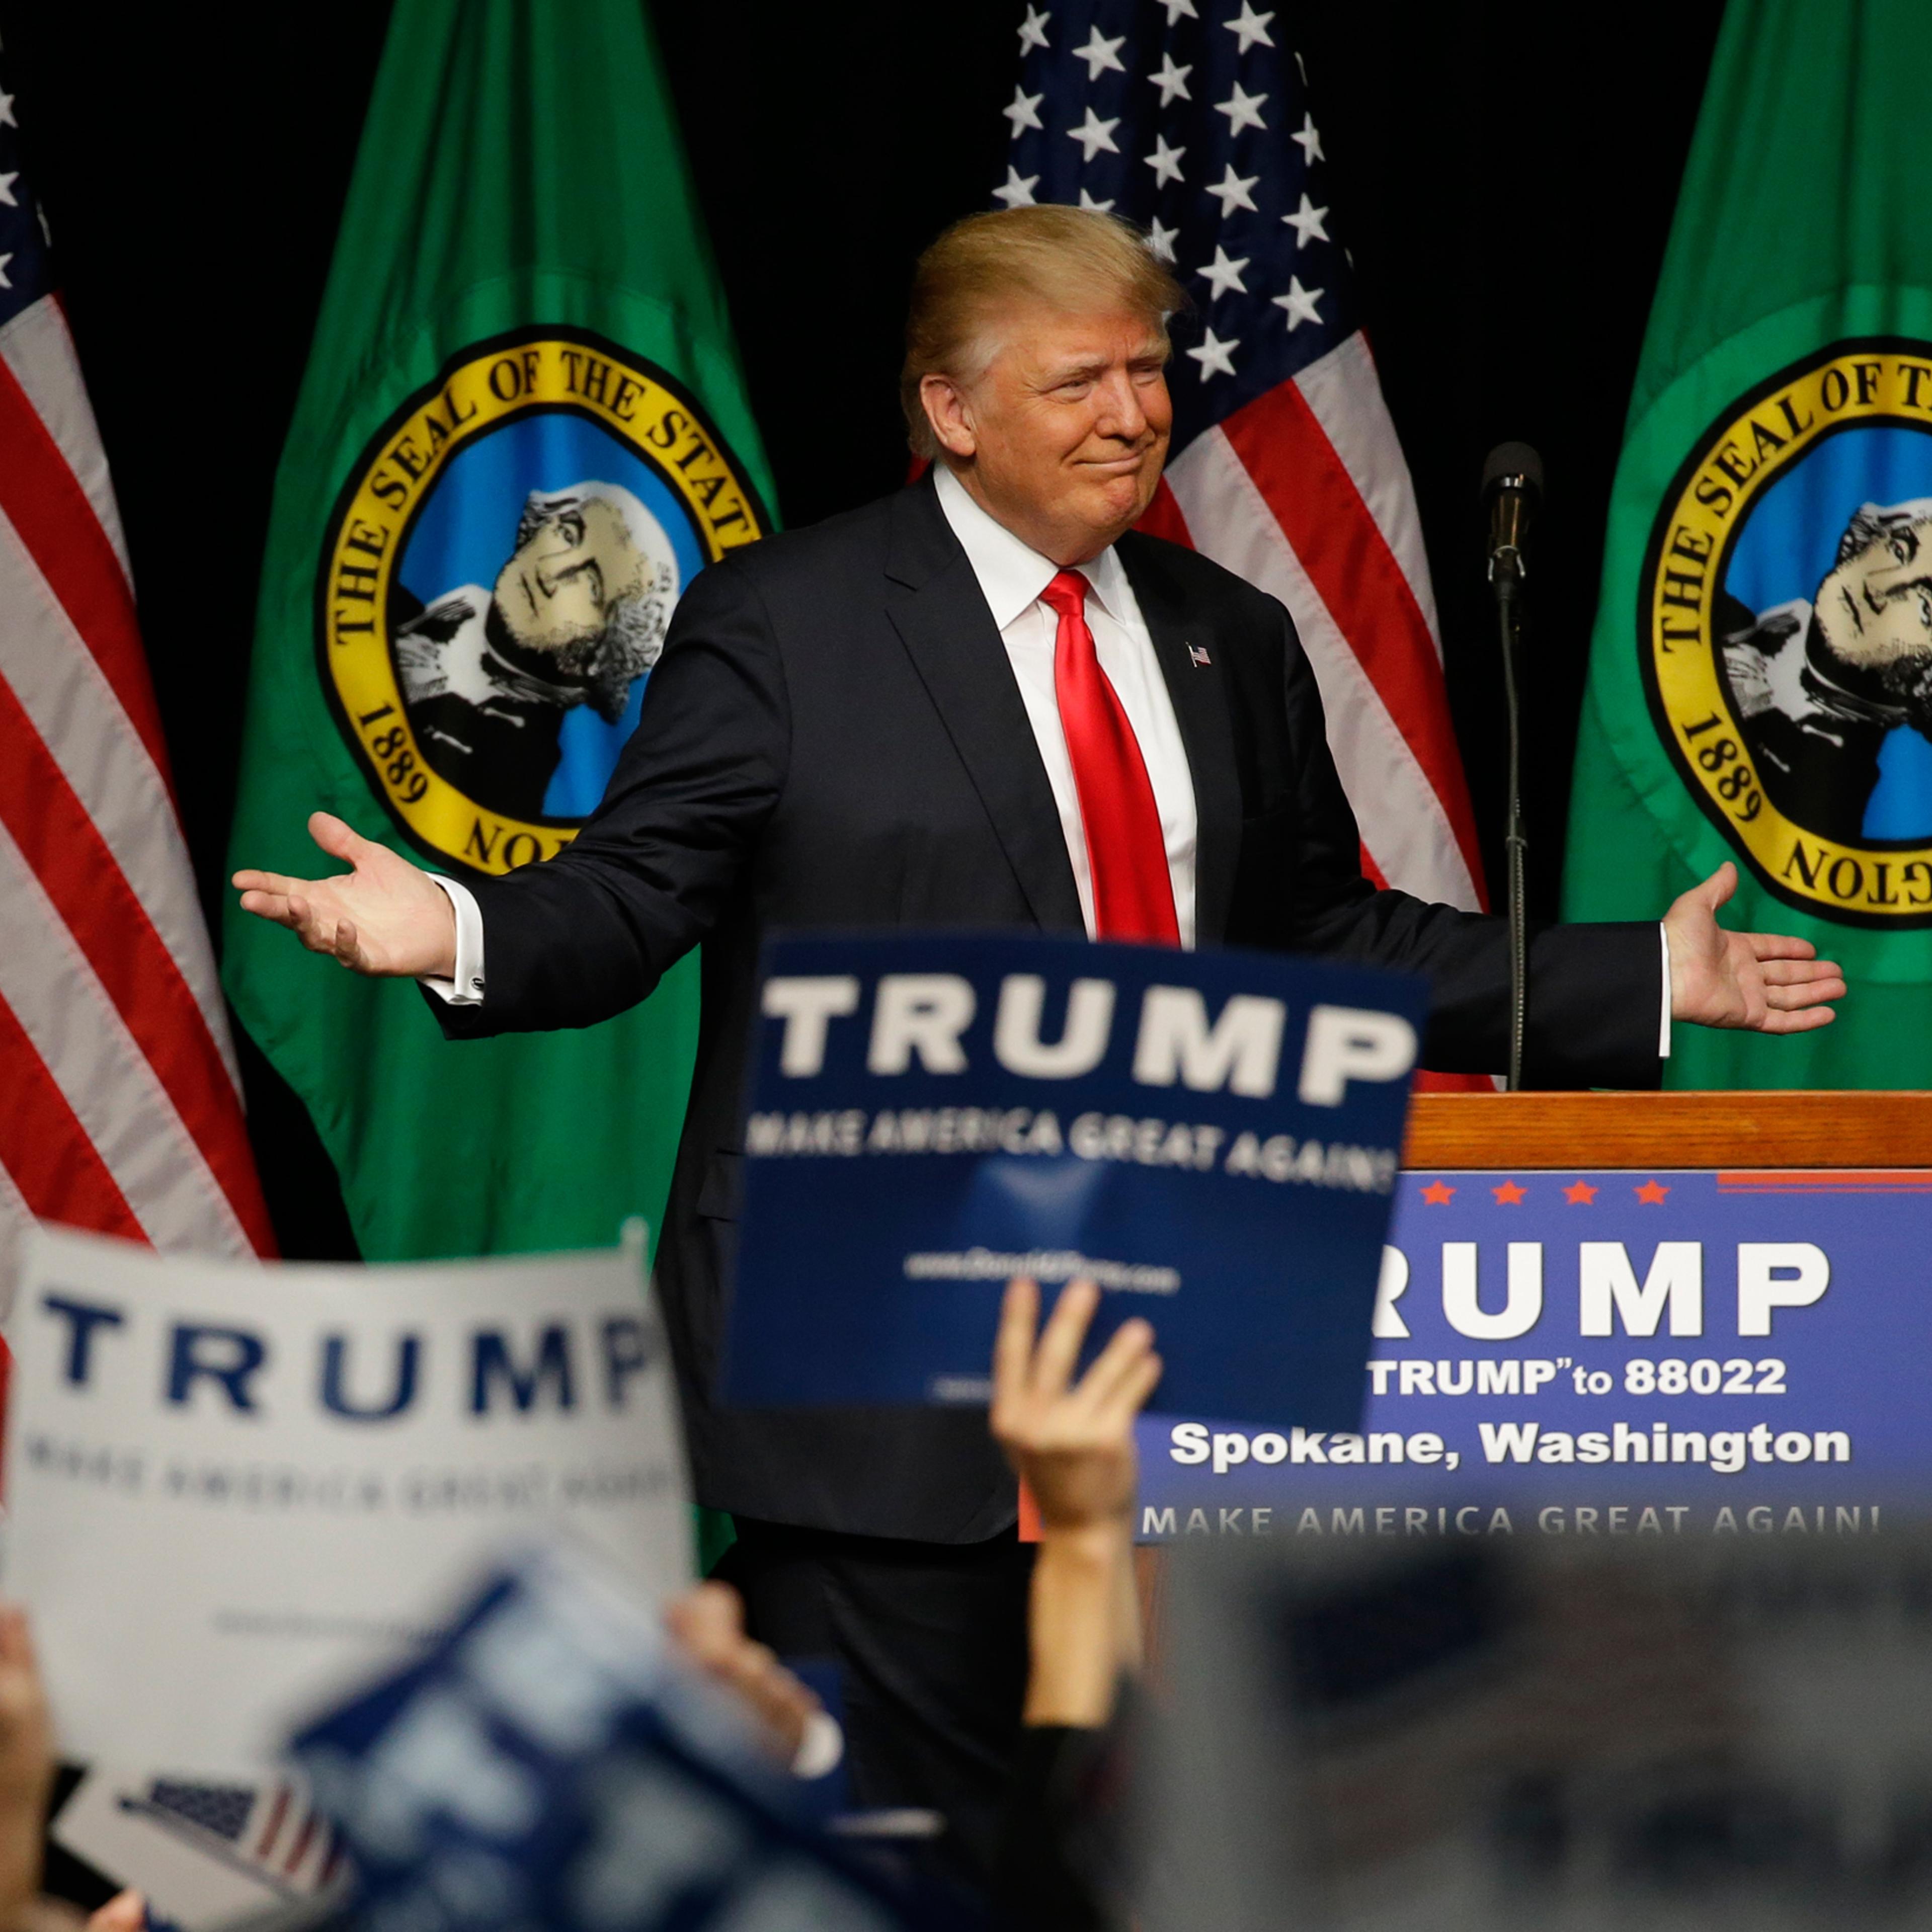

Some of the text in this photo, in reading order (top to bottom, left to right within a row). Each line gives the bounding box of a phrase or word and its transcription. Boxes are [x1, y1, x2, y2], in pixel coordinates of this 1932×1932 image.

[336, 350, 751, 646] THE SEAL OF THE STAT
[1662, 524, 1715, 654] THE
[1695, 396, 1814, 520] SEAL
[1821, 362, 1882, 412] OF
[358, 699, 428, 804] 1889
[1681, 710, 1762, 823] 1889
[761, 973, 1418, 1107] TRUMP
[41, 1290, 649, 1423] TRUMP
[1572, 1366, 1613, 1395] to
[1624, 1358, 1787, 1395] 88022
[1170, 1422, 1850, 1474] Spokane, Washington
[1142, 1506, 1880, 1537] MAKE AMERICA GREAT AGAIN!
